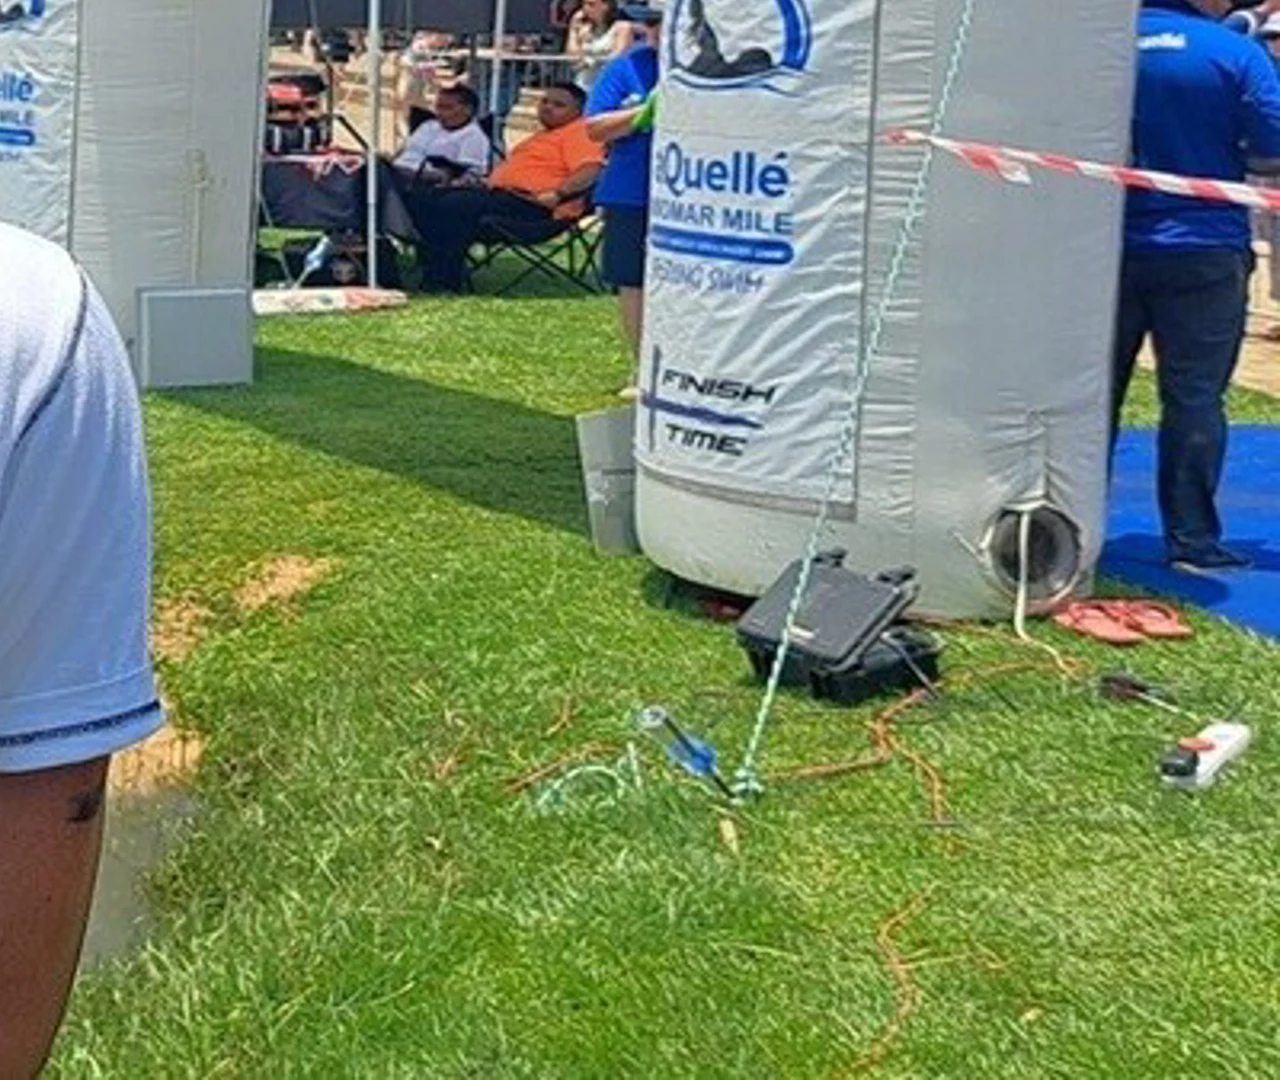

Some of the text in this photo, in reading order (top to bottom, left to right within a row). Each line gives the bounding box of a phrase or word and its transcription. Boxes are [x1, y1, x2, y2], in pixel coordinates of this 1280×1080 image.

[721, 206, 794, 235] MILE
[662, 369, 776, 403] FINISH
[665, 423, 748, 457] TIME
